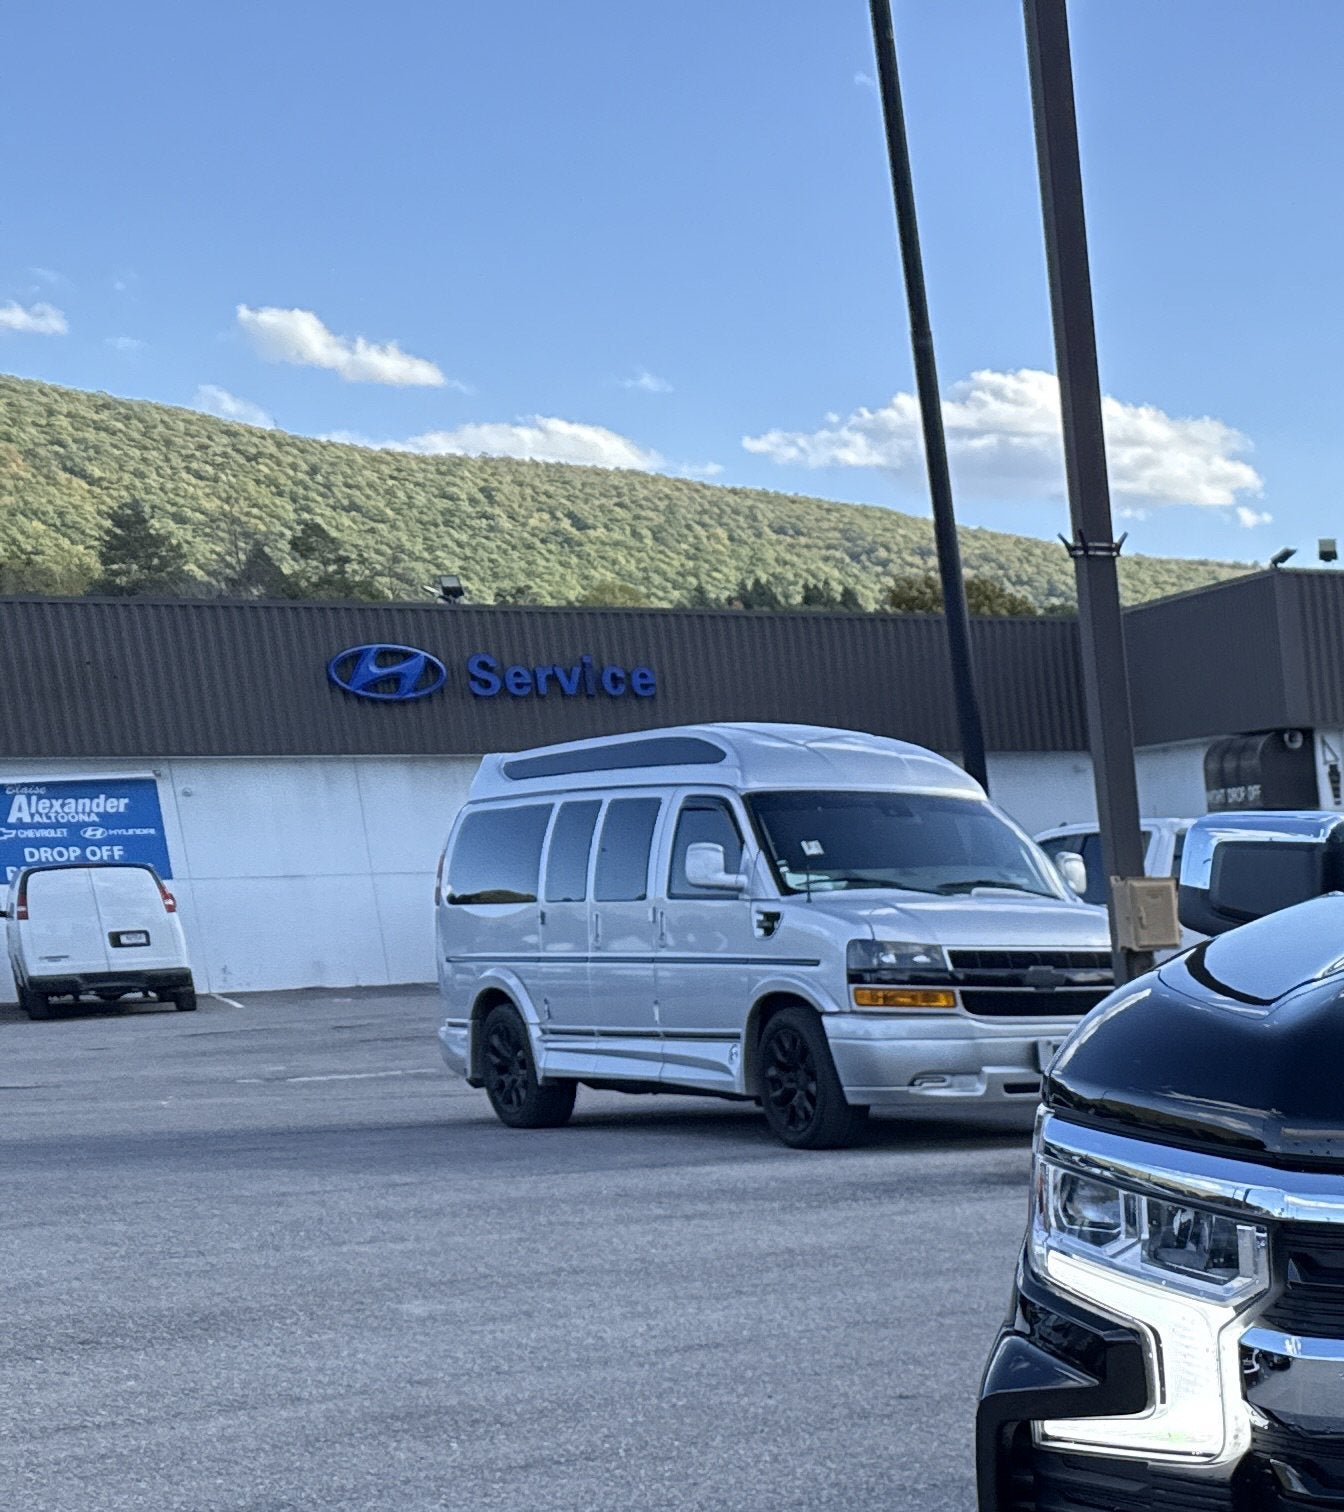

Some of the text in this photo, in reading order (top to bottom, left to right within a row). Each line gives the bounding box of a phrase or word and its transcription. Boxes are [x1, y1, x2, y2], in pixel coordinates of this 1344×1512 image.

[467, 653, 657, 697] Service
[7, 794, 129, 823] Alexander
[32, 812, 100, 823] ALTOONA
[18, 828, 68, 838] CHEVROLET
[24, 845, 124, 862] DROP OFF
